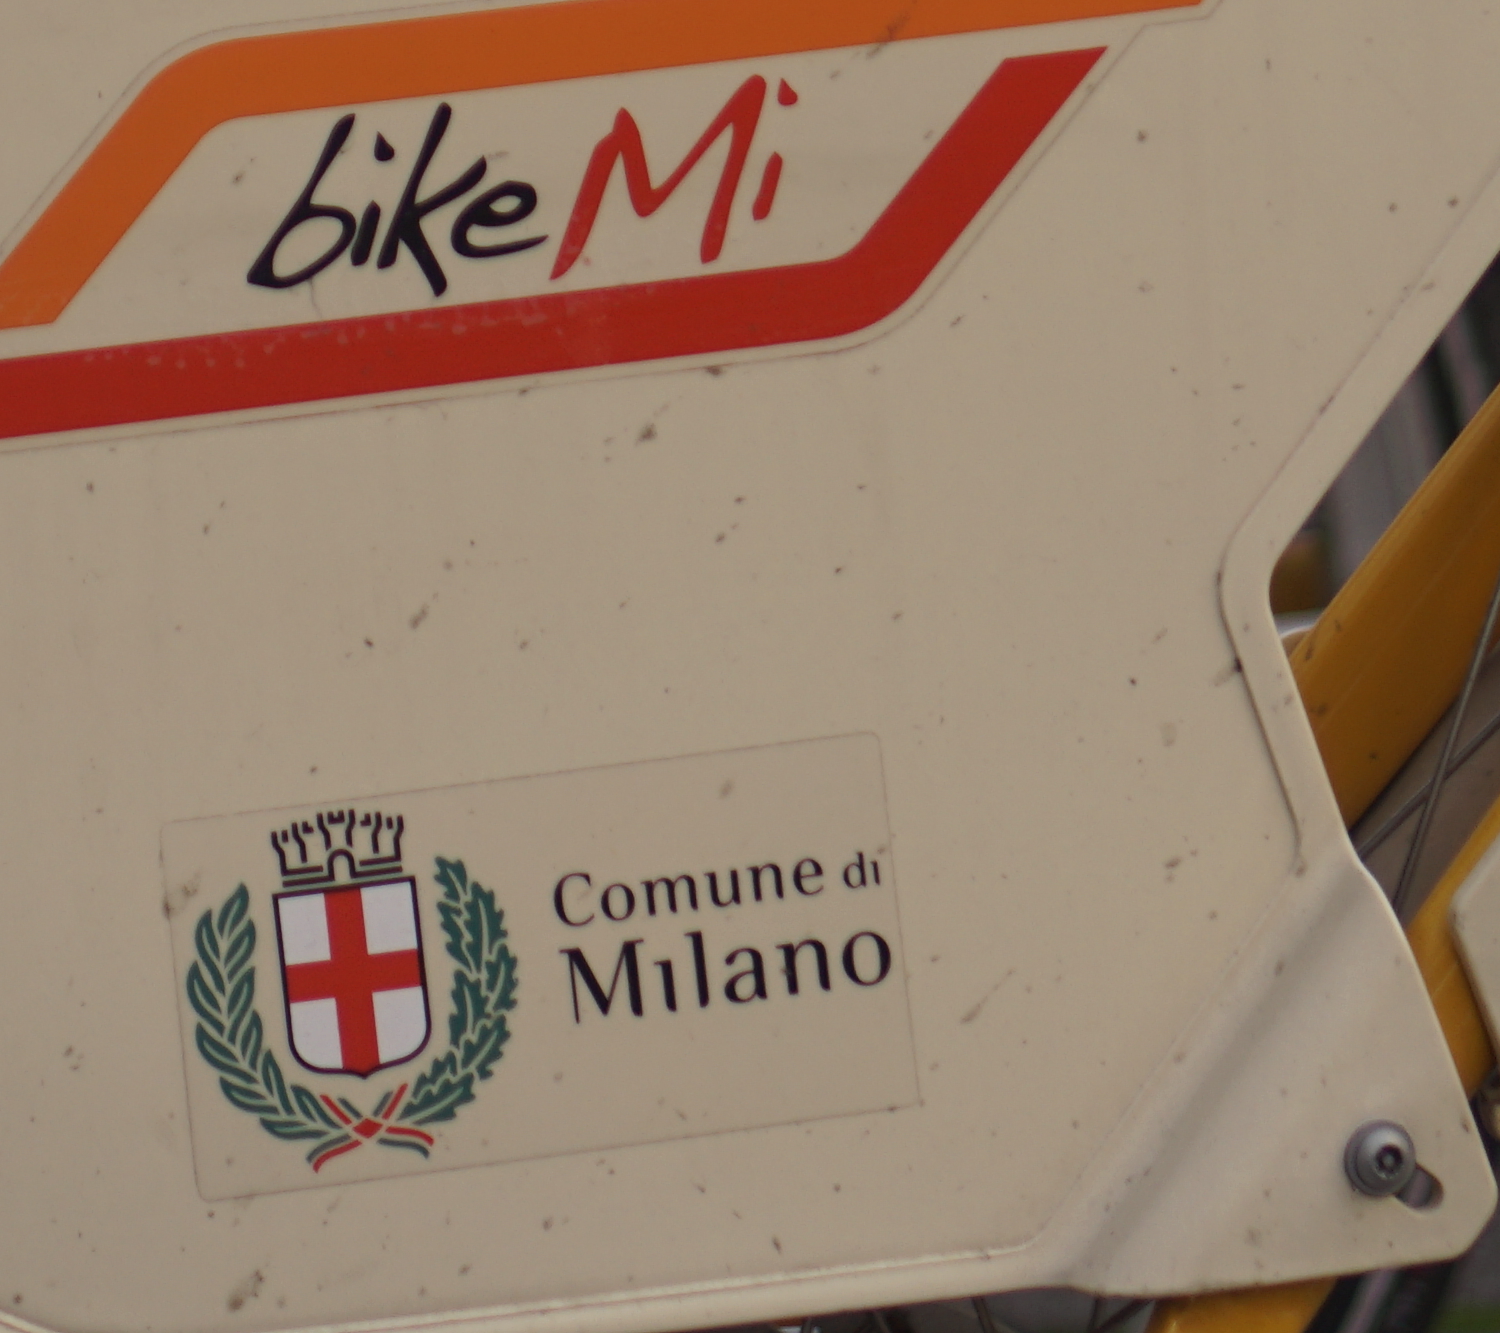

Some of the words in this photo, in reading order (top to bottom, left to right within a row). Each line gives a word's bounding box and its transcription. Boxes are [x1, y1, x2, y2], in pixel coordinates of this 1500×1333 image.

[244, 72, 800, 298] bikeMi
[552, 855, 825, 928] Comune
[842, 850, 883, 889] di
[557, 928, 894, 1024] Milano
